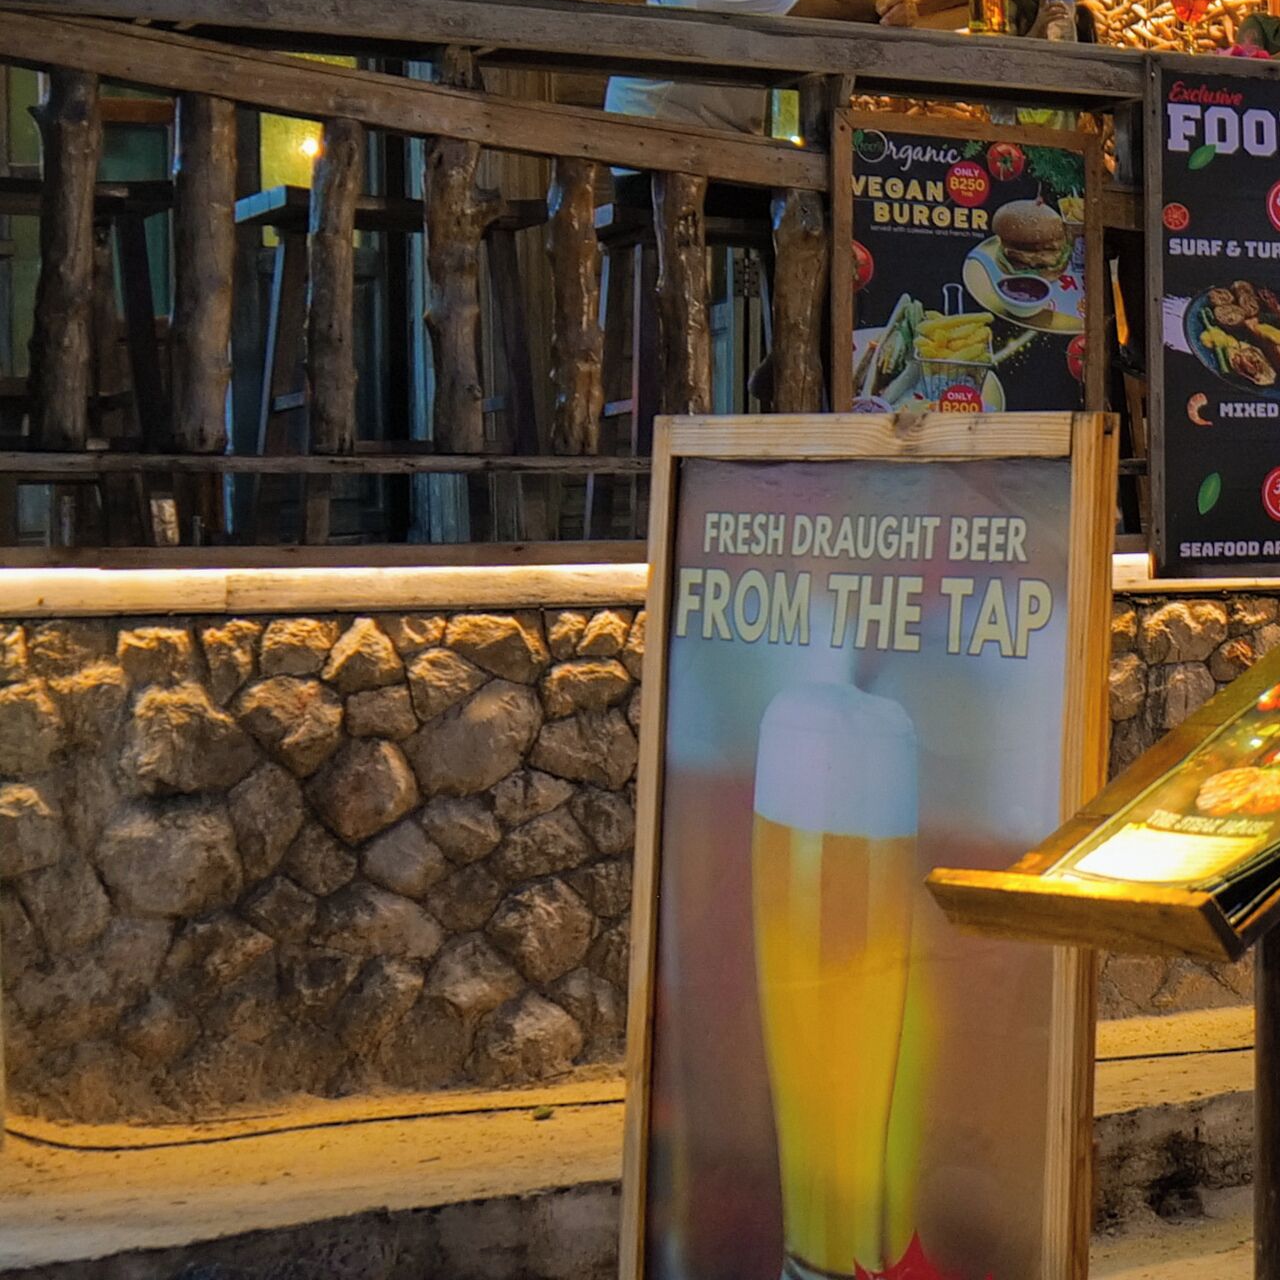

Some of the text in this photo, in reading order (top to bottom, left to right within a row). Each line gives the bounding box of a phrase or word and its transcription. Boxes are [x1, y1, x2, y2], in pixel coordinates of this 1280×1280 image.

[1169, 80, 1243, 106] Exclusive
[856, 128, 961, 171] Organic
[954, 168, 980, 177] ONLY
[852, 175, 944, 202] VEGAN
[874, 202, 988, 230] BURGER
[1169, 238, 1222, 257] SURF
[1227, 239, 1241, 257] &
[947, 392, 972, 401] ONLY
[1220, 402, 1279, 418] MIXED
[704, 513, 1028, 562] FRESH DRAUGHT BEER
[1180, 541, 1260, 558] SEAFOOD
[675, 568, 1054, 658] FROM THE TAP
